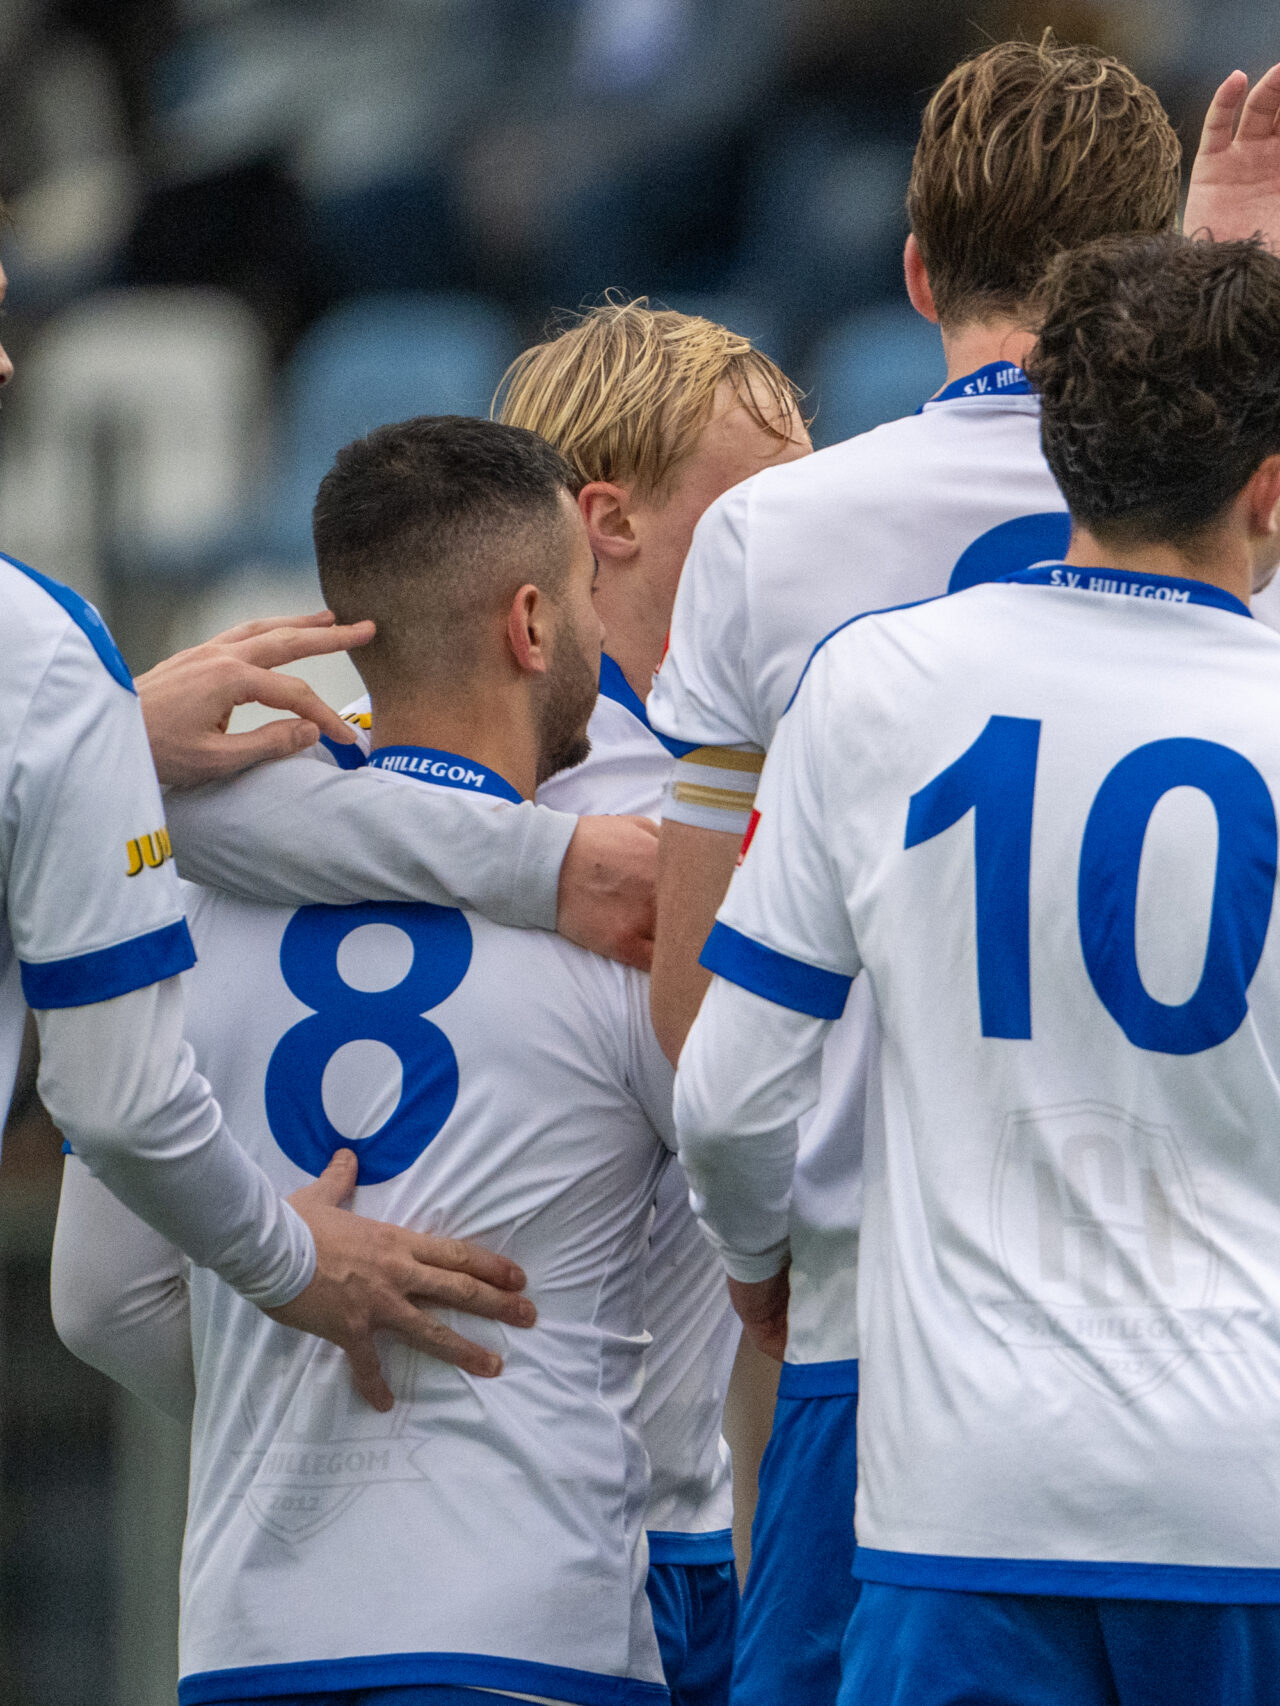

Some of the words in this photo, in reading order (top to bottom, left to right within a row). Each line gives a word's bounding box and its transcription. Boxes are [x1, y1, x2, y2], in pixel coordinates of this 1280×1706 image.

[1088, 577, 1190, 603] HILLEGOM
[381, 756, 485, 788] HILLEGOM
[903, 715, 1278, 1056] 10
[265, 900, 473, 1186] 8
